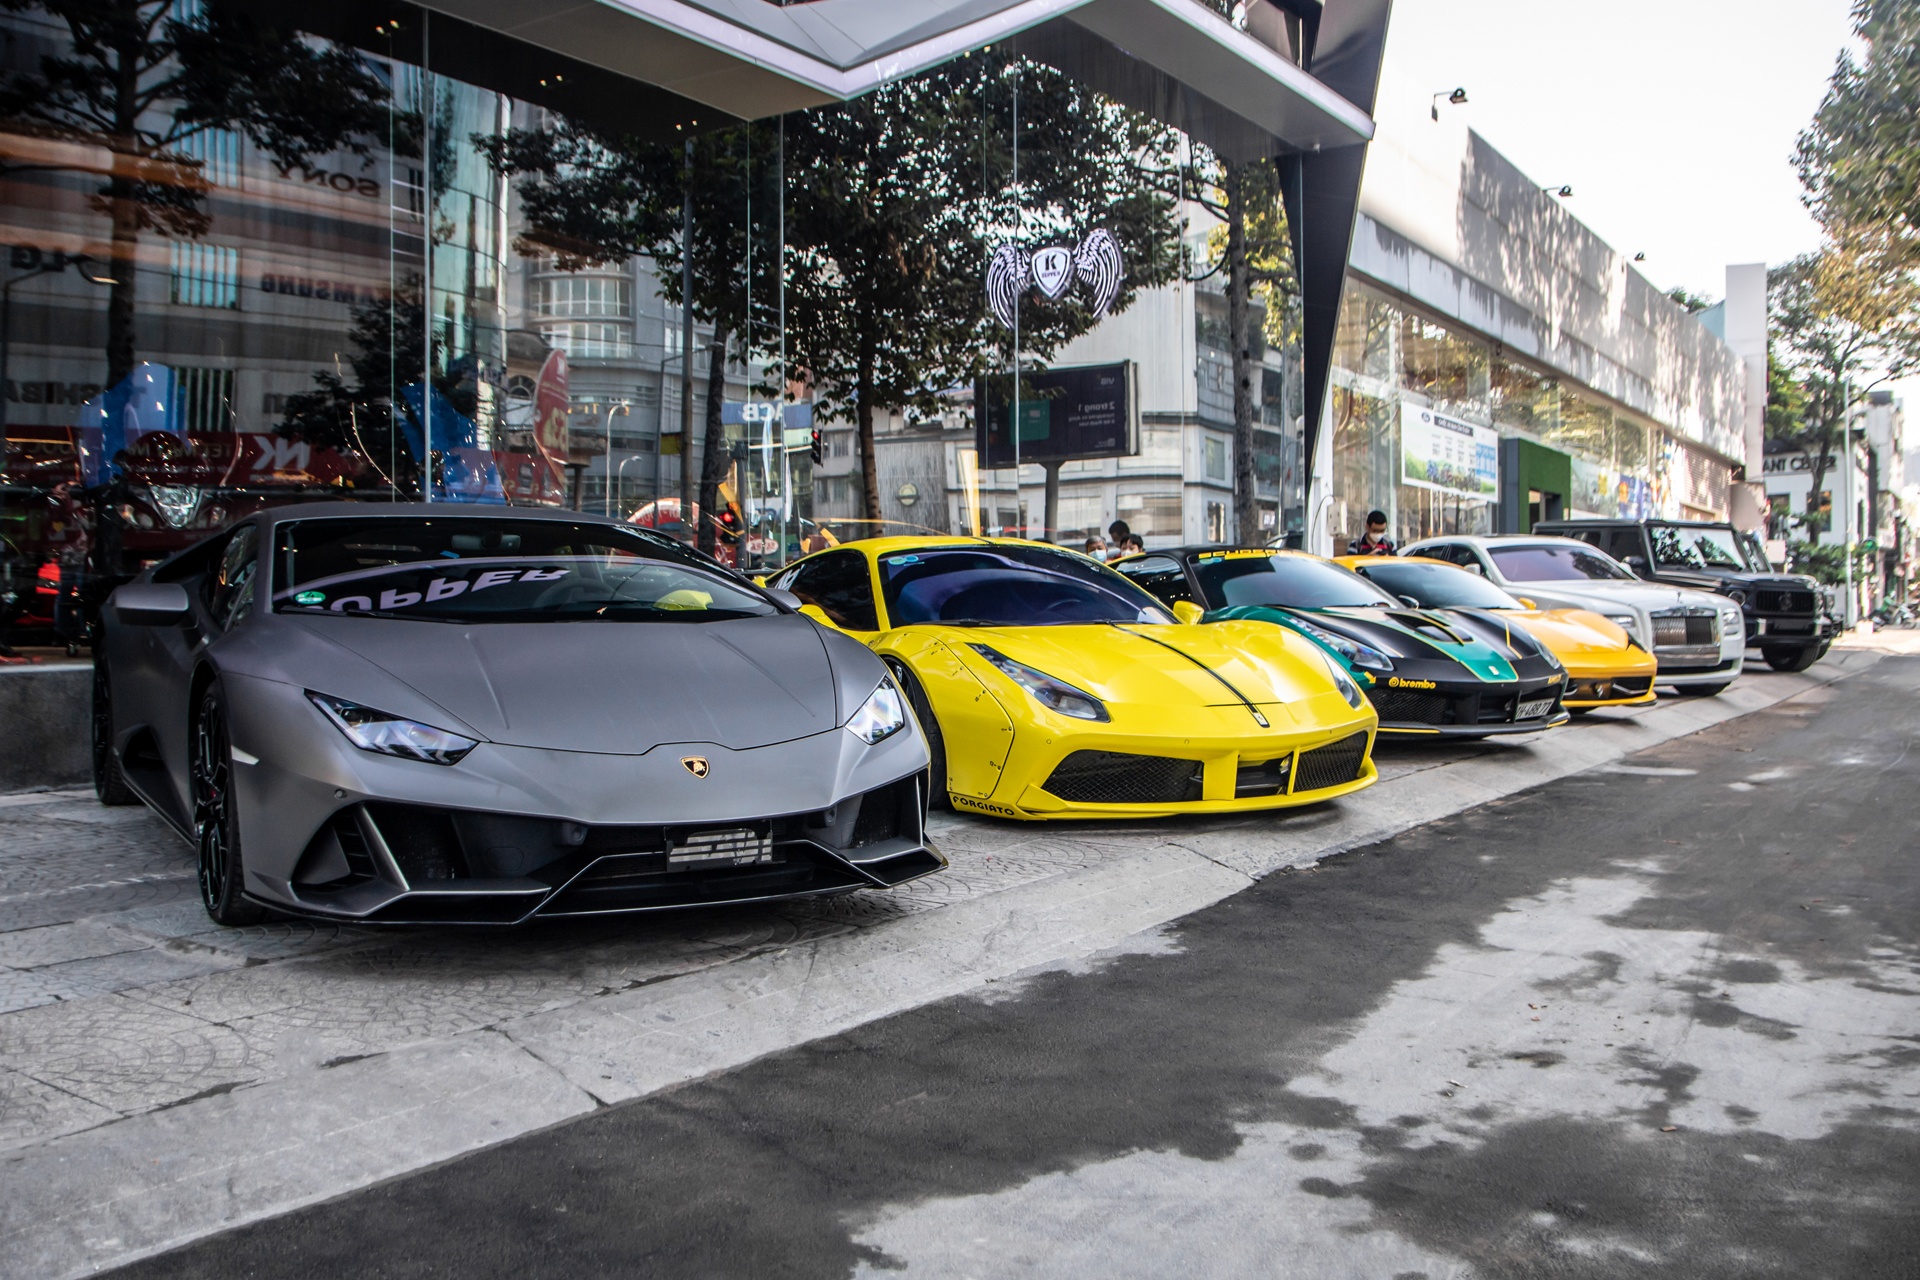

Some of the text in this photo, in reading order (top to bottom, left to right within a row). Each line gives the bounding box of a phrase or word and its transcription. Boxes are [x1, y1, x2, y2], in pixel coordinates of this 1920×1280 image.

[1045, 254, 1057, 271] K
[1399, 678, 1436, 690] brembo
[952, 796, 1015, 816] FORGIATO
